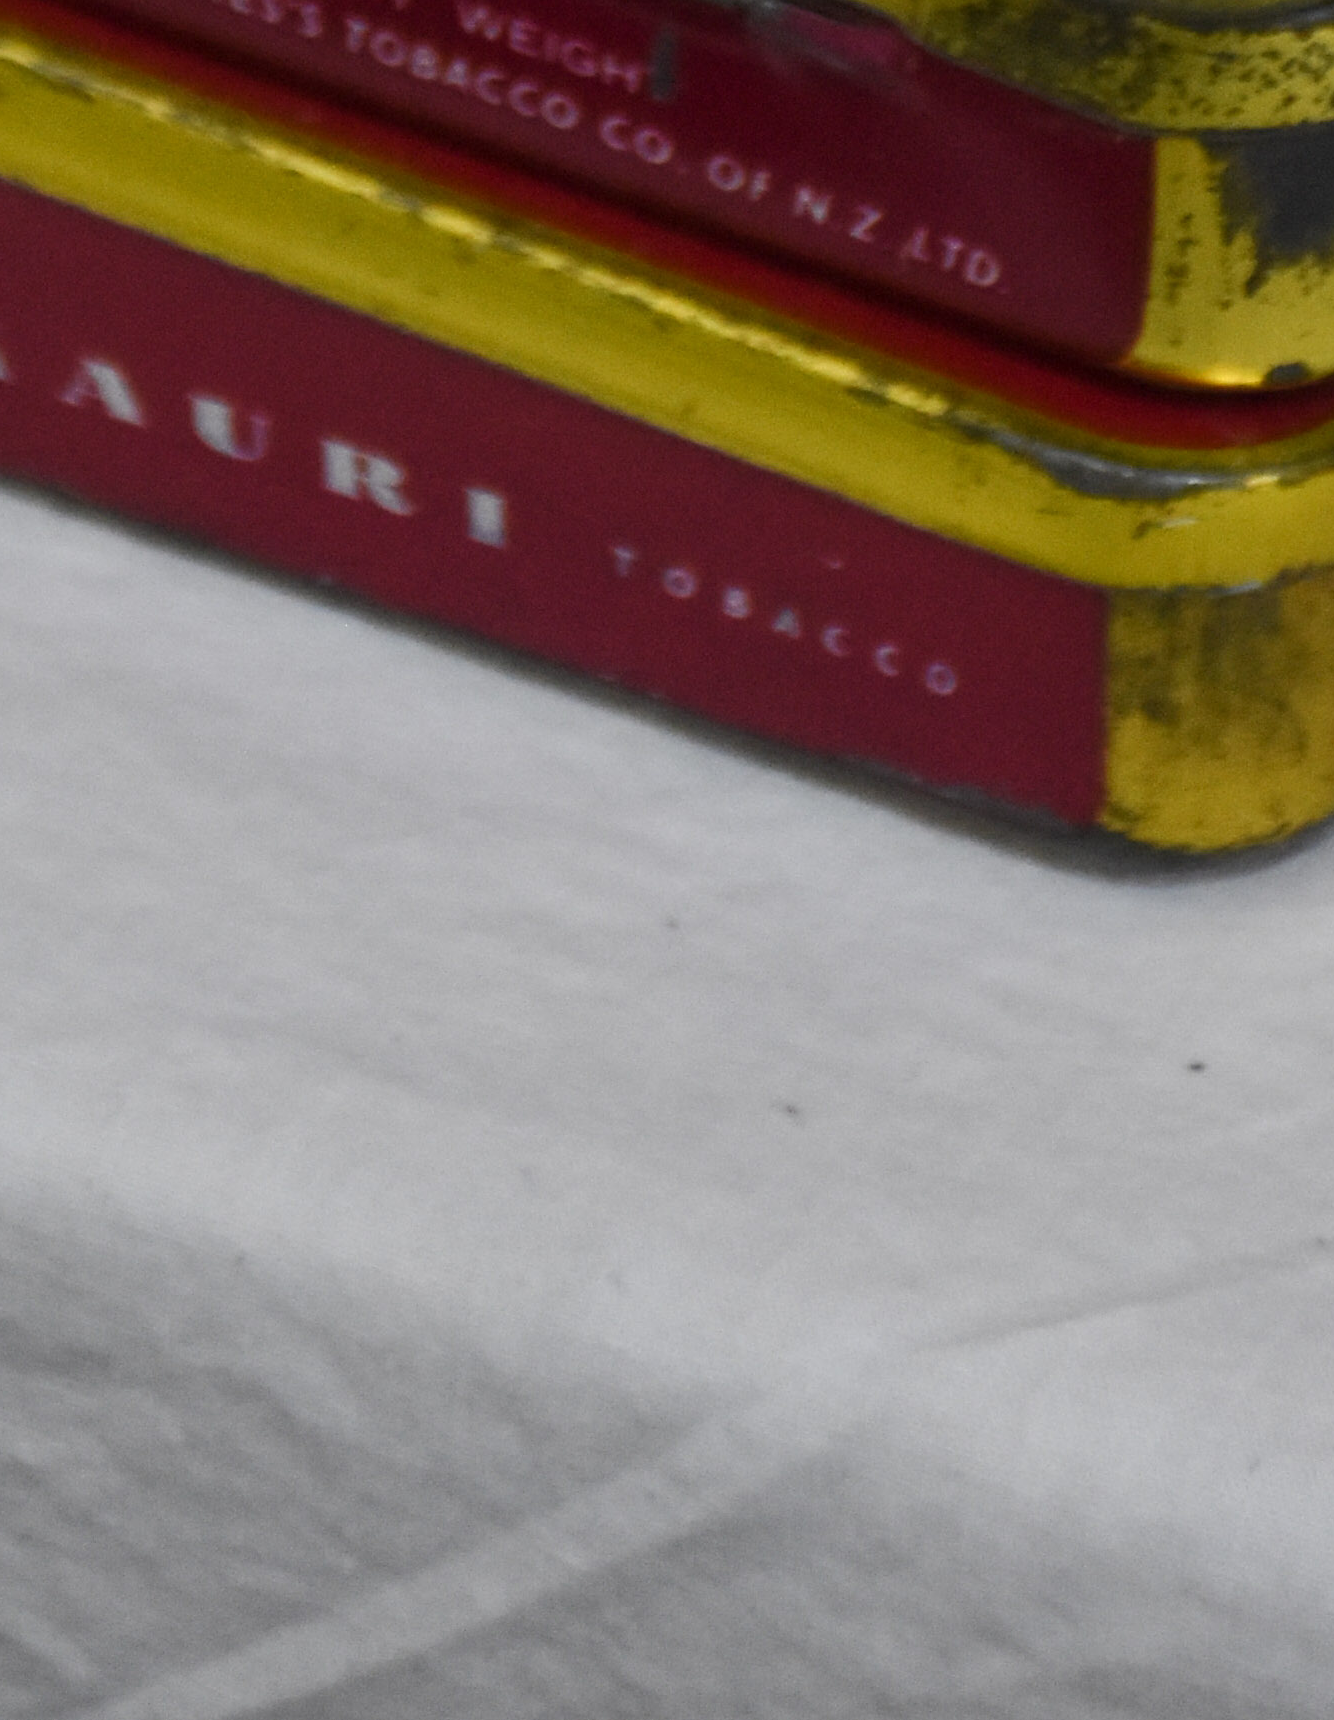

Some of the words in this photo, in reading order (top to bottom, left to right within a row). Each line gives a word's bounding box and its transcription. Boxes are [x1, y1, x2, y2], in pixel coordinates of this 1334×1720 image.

[344, 17, 581, 131] TOBACCO
[457, 5, 649, 93] WEIGH
[610, 544, 960, 697] TOBACCO
